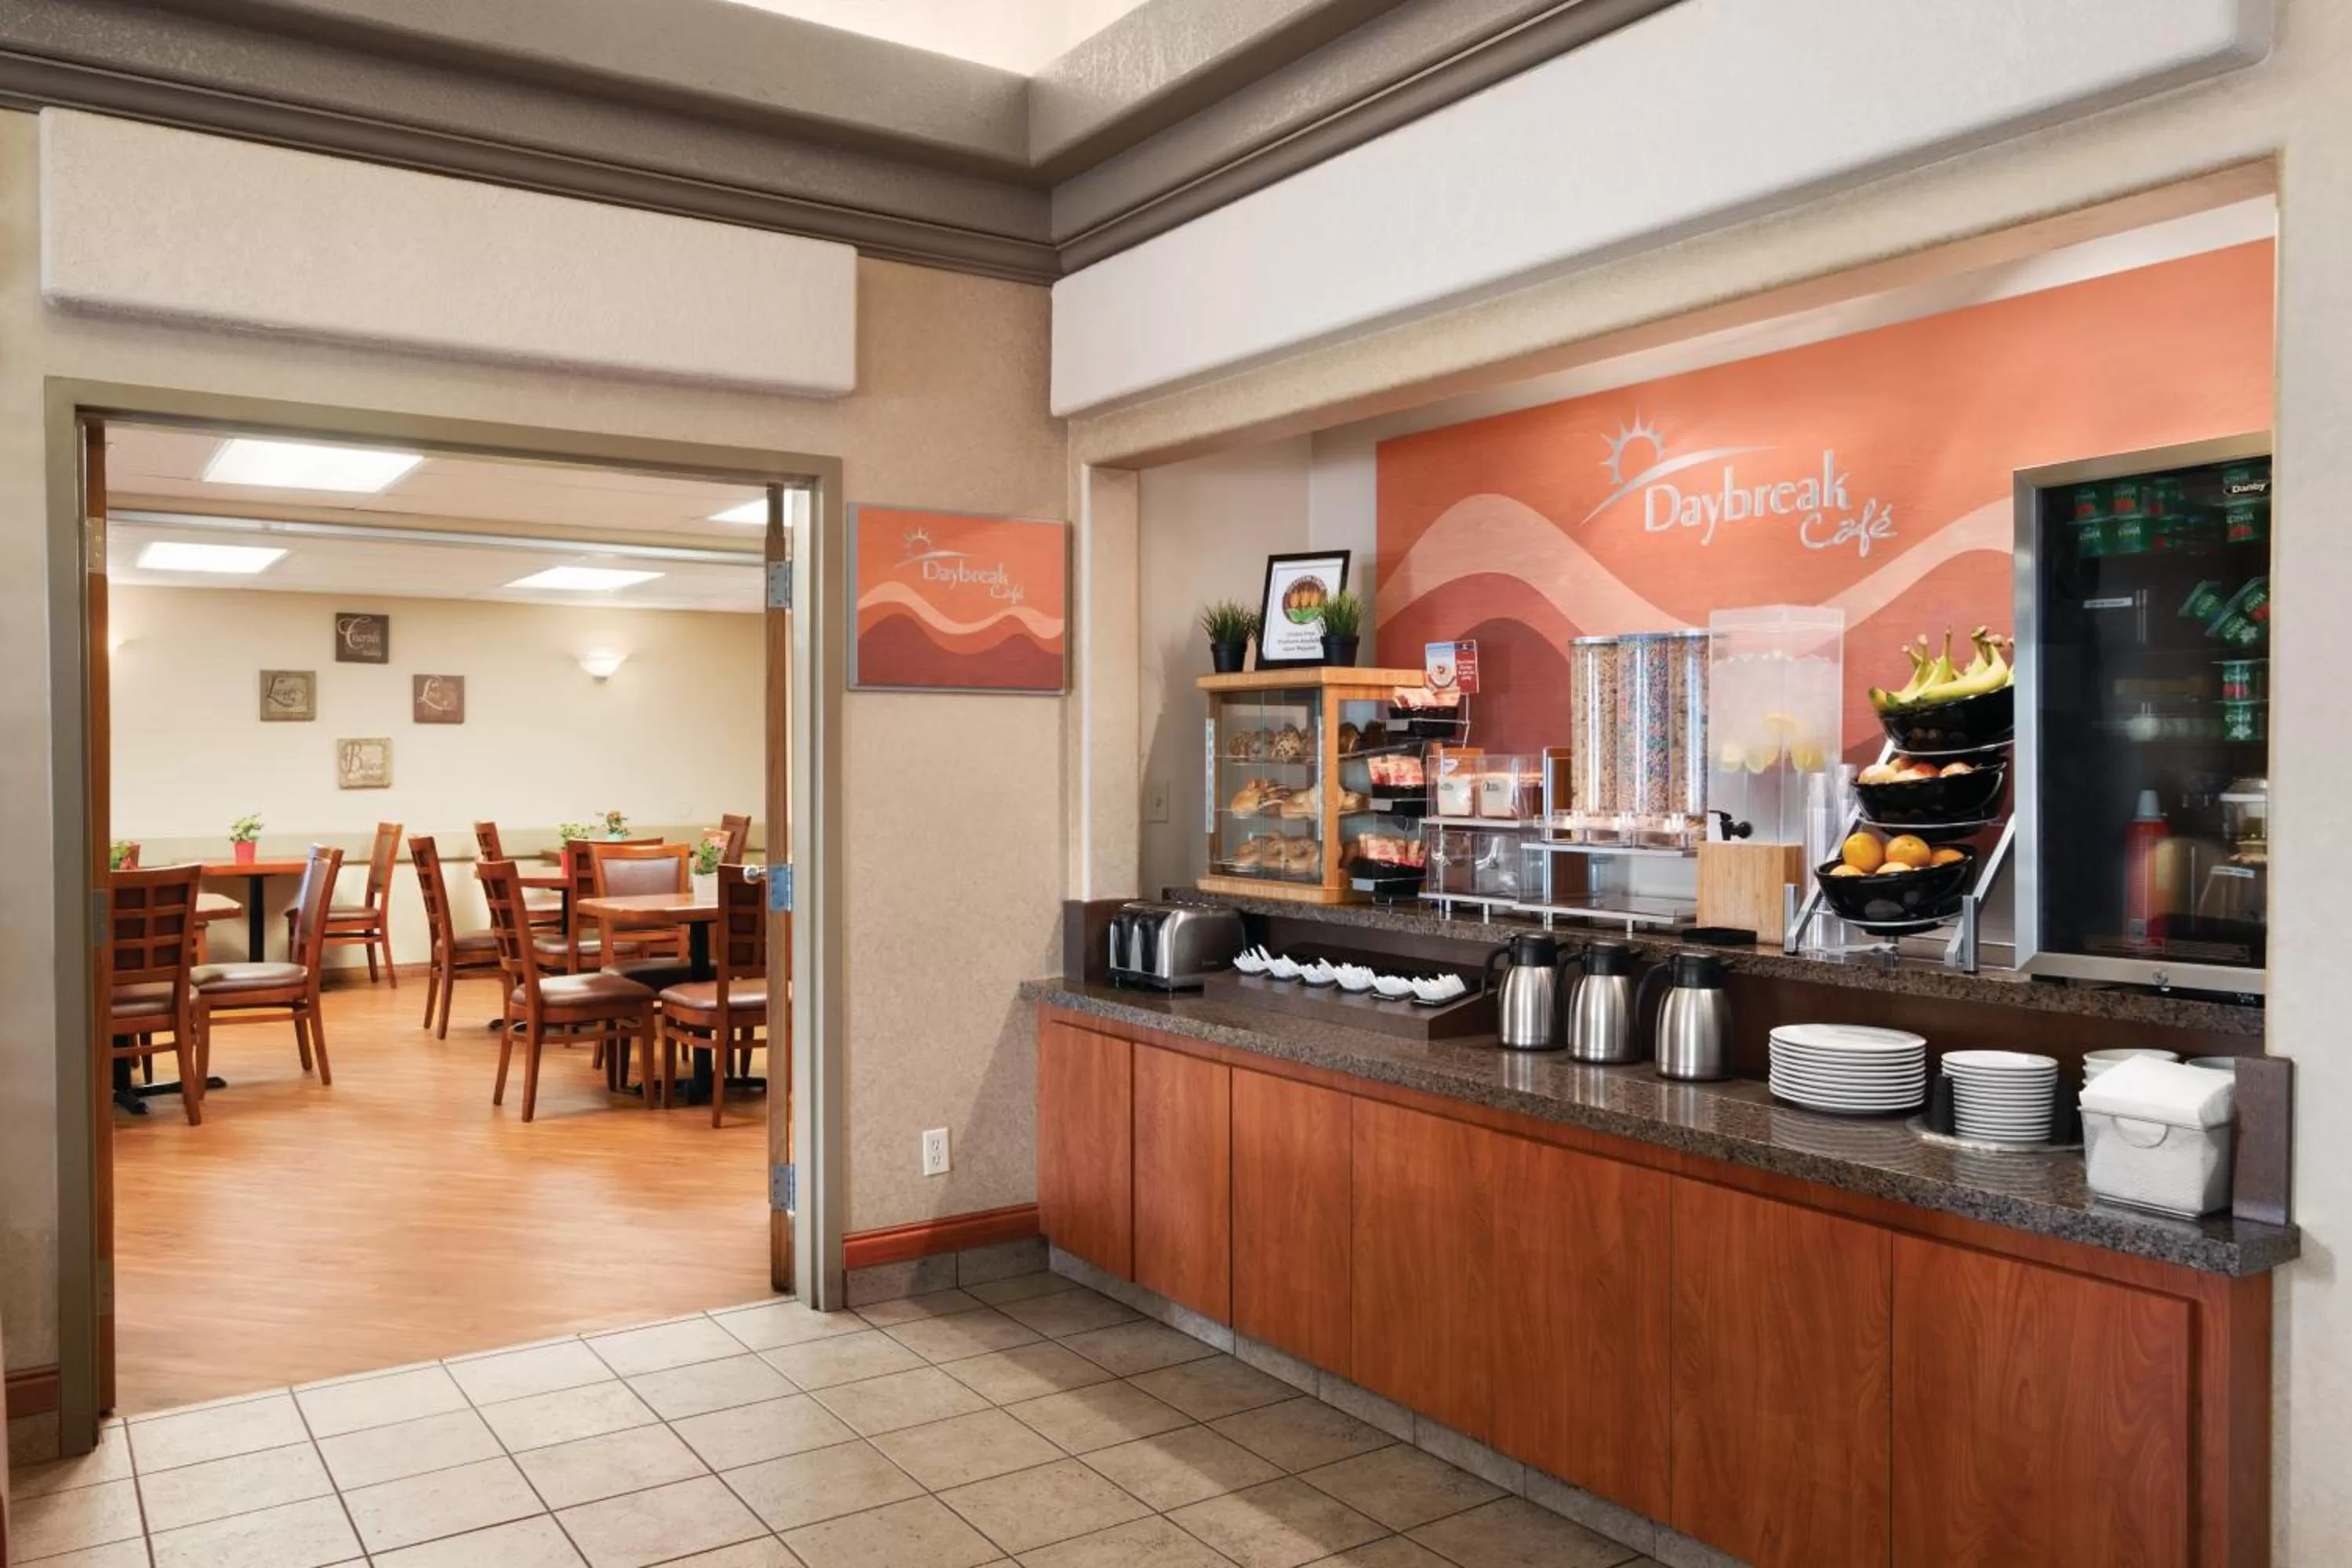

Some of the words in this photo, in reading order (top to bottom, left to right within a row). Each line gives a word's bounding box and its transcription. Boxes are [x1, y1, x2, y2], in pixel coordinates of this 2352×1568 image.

[1645, 449, 1851, 546] Daybreak
[2231, 481, 2267, 494] Danby
[1799, 498, 1899, 558] Café
[923, 557, 1009, 590] Daybreak
